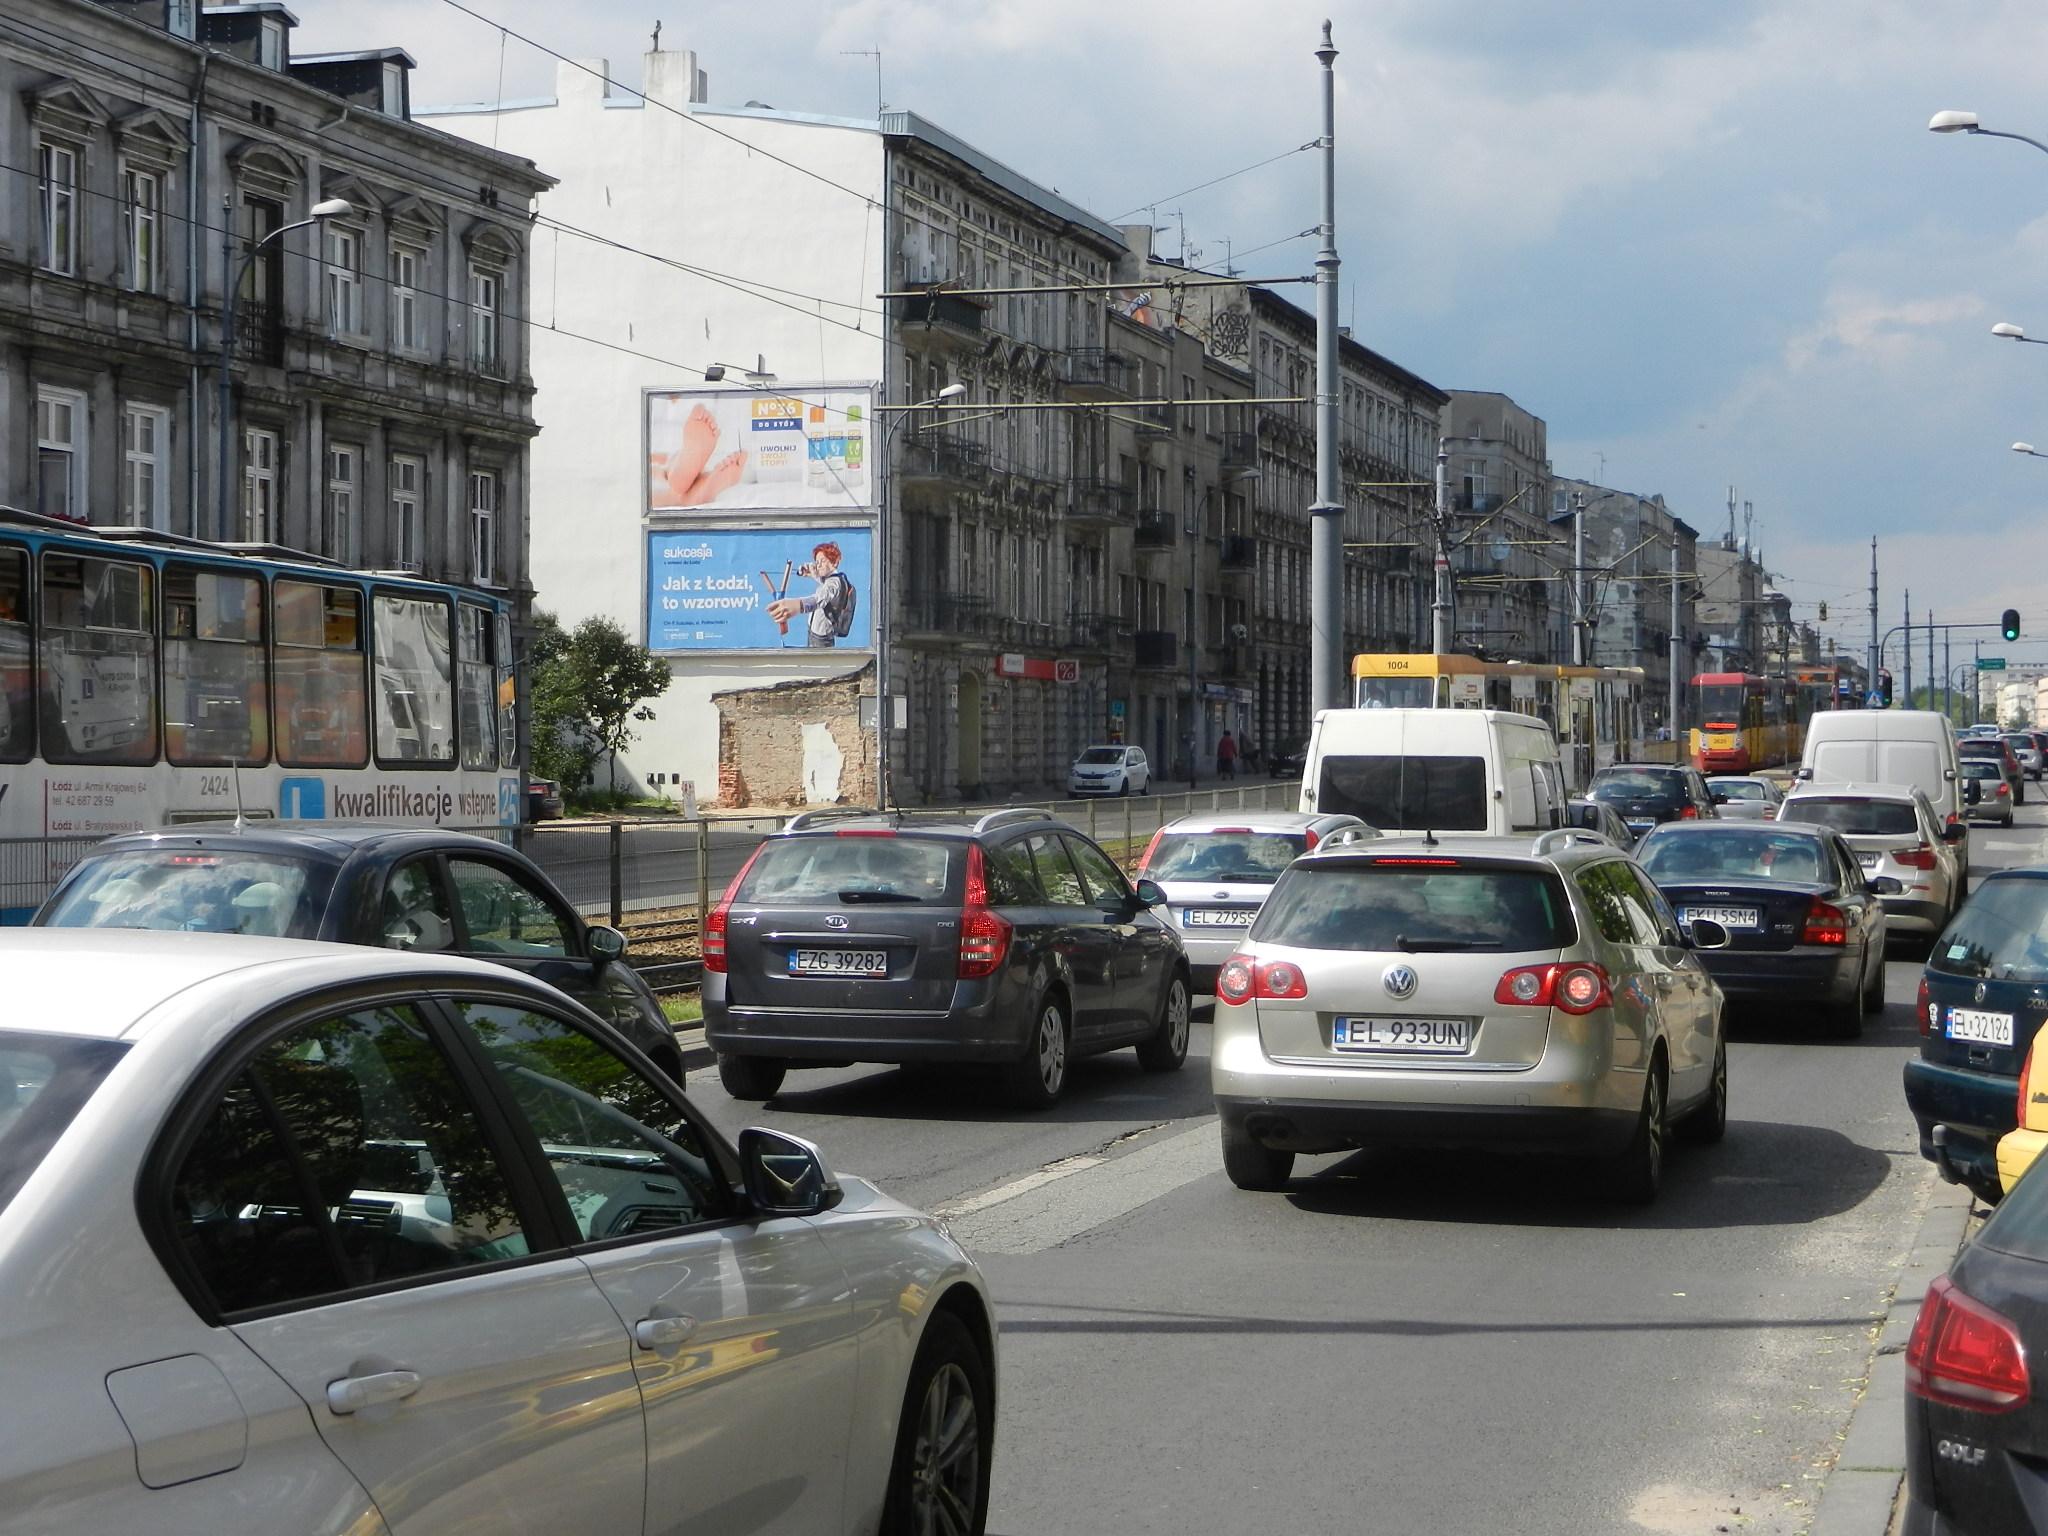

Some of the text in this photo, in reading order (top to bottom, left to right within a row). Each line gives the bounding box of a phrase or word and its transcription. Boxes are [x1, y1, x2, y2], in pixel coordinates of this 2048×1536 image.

[662, 575, 753, 592] Jak z Łodzi,
[662, 592, 760, 611] to wzorowy!
[1387, 661, 1409, 670] 1004
[52, 781, 72, 791] Łódź
[201, 776, 228, 795] 2424
[334, 785, 496, 824] kwalifikacje wstępne
[52, 820, 72, 830] Łódź
[827, 917, 847, 926] KIA
[1193, 911, 1209, 923] EL
[1722, 910, 1756, 923] 5SN4
[798, 952, 885, 971] EZG 39282
[1350, 1021, 1462, 1045] EL 933UN
[1955, 1013, 1968, 1036] EL
[1974, 1015, 2009, 1041] 32126
